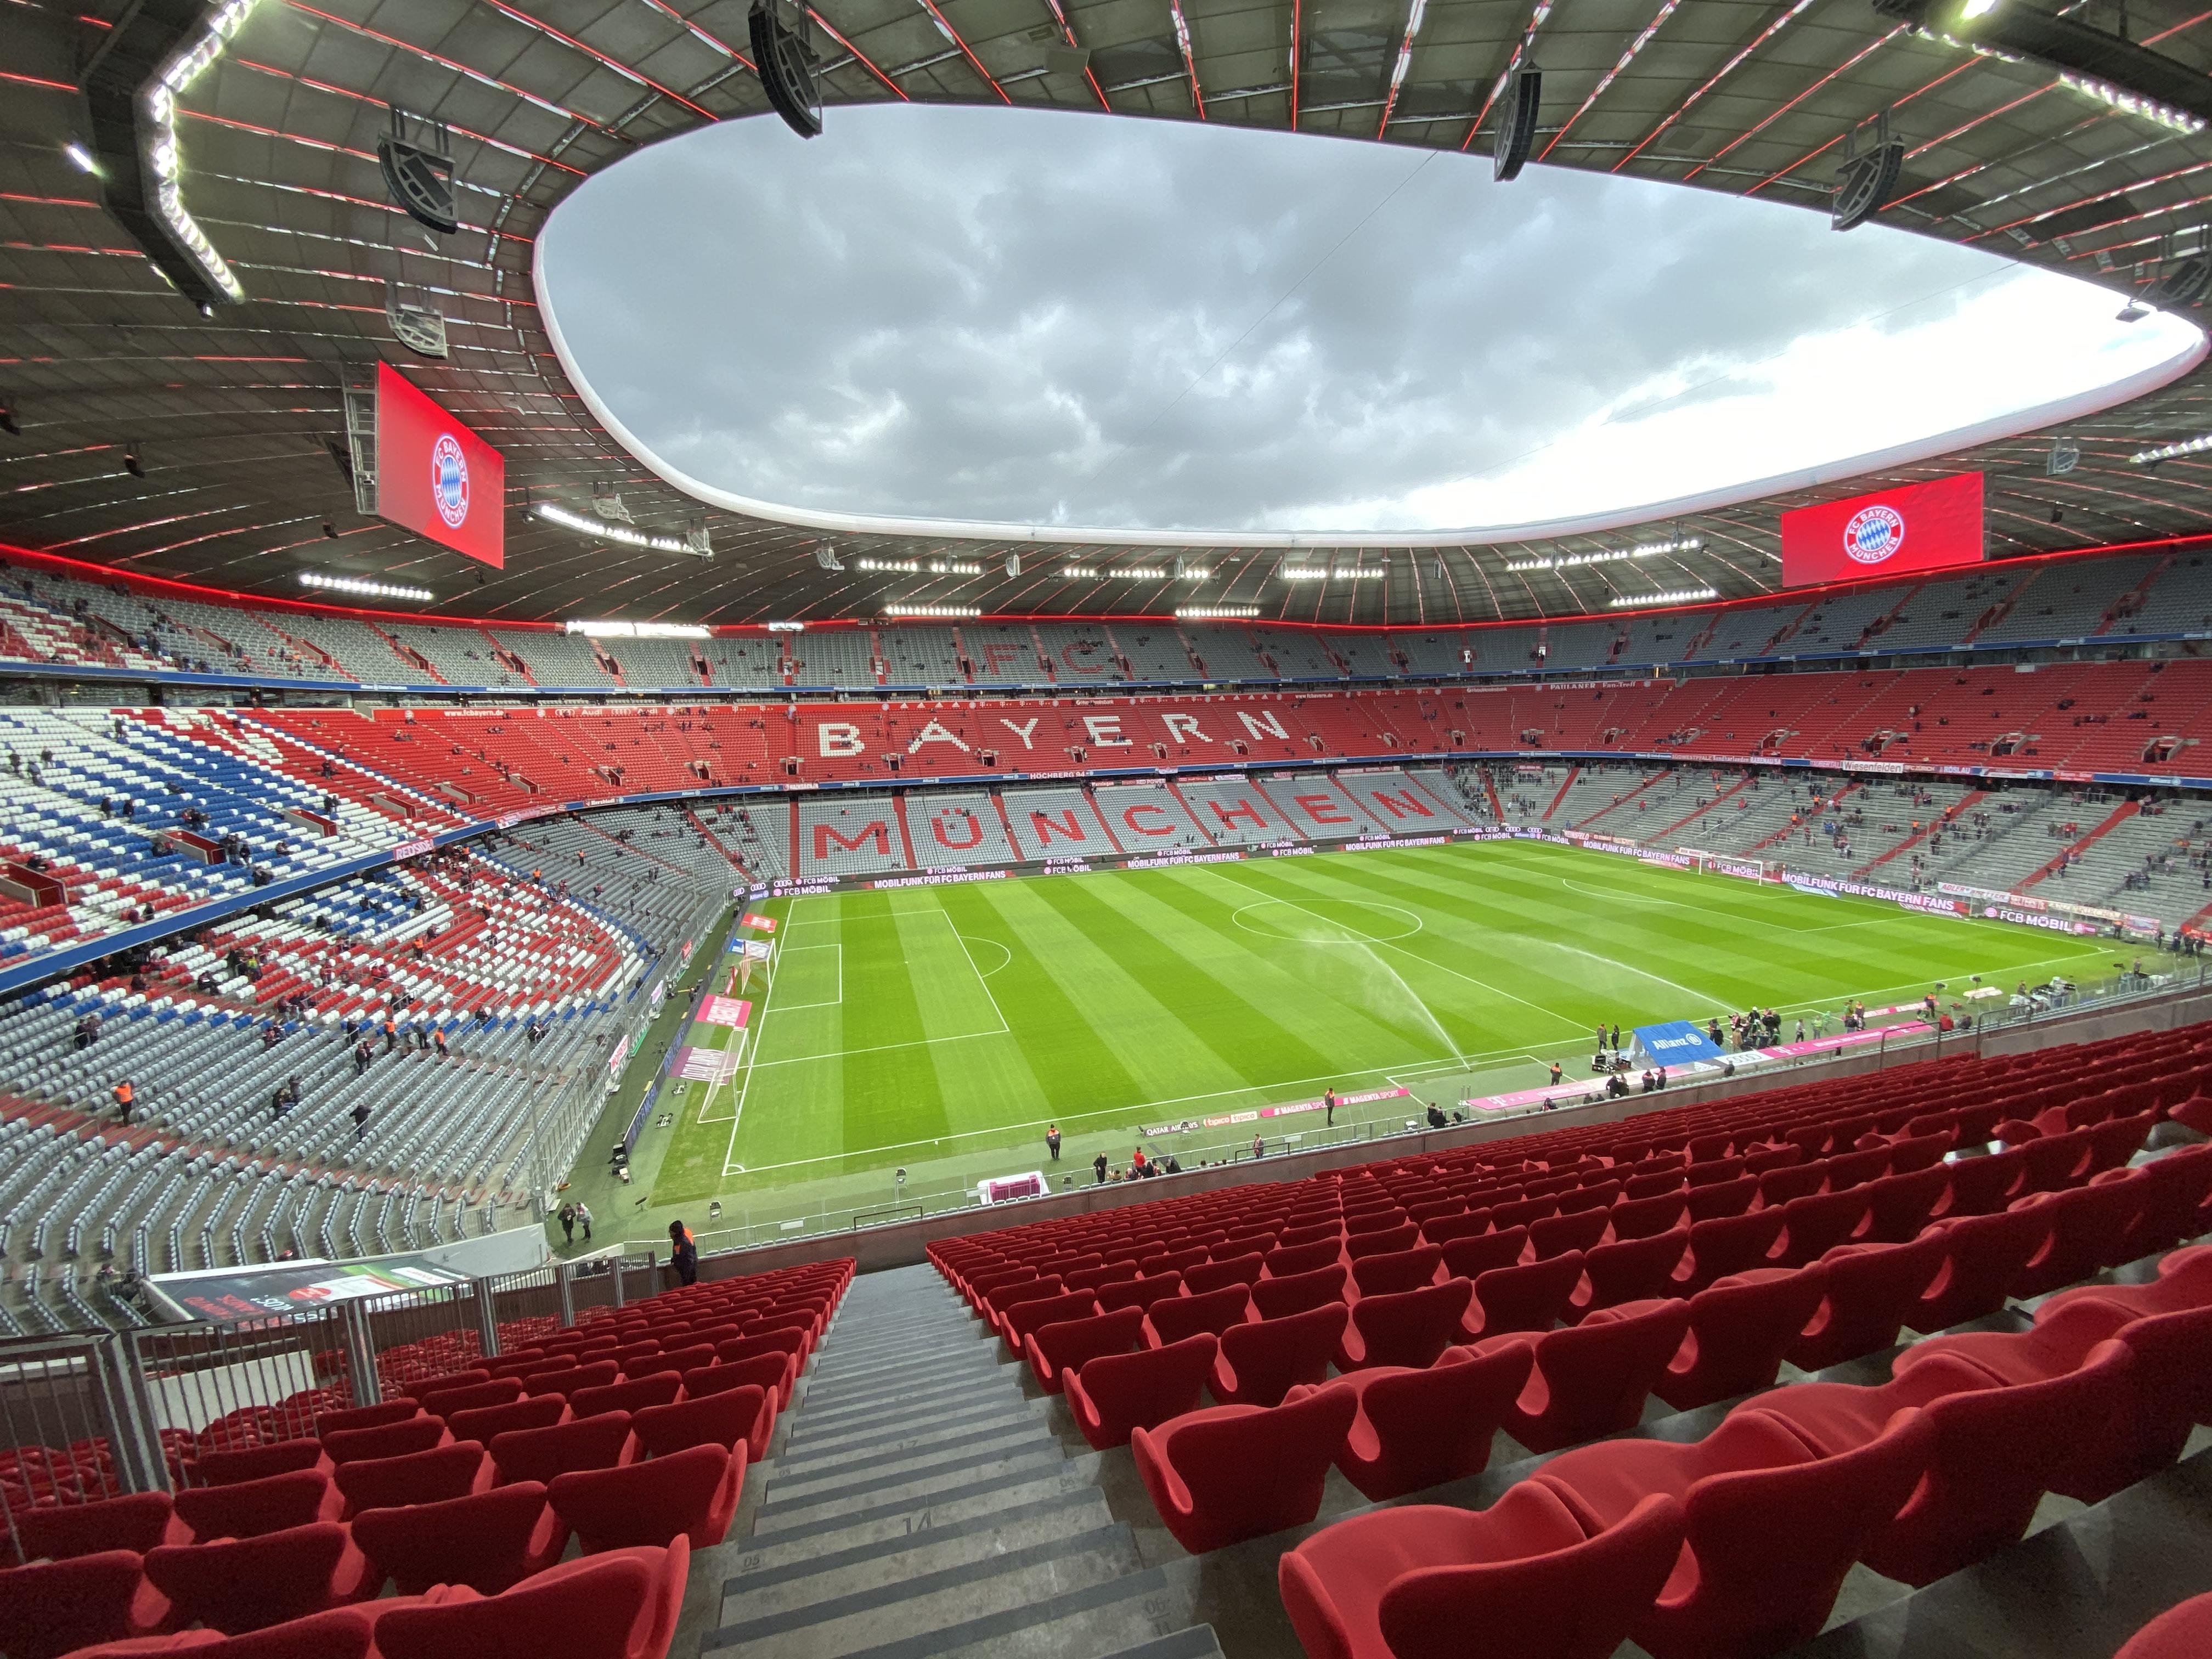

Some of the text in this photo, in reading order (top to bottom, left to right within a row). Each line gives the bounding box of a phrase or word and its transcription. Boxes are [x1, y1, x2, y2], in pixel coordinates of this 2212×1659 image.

[436, 441, 466, 483] FC BAYERN
[1849, 509, 1899, 535] FC BAYERN
[985, 643, 1104, 674] FC
[444, 709, 504, 718] www.fcbayern.de
[819, 710, 1289, 757] BAYERN
[1844, 761, 1901, 773] Wiesenfelden
[813, 789, 1434, 859] MÜNCHEN
[1346, 842, 1383, 851] MOBILFUNK
[1383, 840, 1395, 848] FÜR
[1404, 838, 1429, 847] BAYERN
[1430, 836, 1445, 844] FANS
[1552, 836, 1570, 845] MÖBIL
[1293, 847, 1314, 855] MÖBIL
[1583, 840, 1619, 854] MOBILFUNK
[1620, 846, 1633, 856] FÜR
[1633, 849, 1642, 857] FC
[1643, 850, 1671, 862] BAYERN
[1671, 853, 1690, 865] FANS
[1127, 852, 1239, 868] MOBILFUNK FÜR FC BAYERN FANS
[1717, 863, 1731, 873] FCB
[817, 876, 840, 884] MÖBIL
[874, 870, 1006, 889] MOBILFUNK FÜR FC BAYERN FANS
[784, 885, 831, 896] FCB MÖBIL
[1782, 873, 1838, 891] MOBILFUNK
[1839, 882, 1860, 895] FÜR
[1861, 887, 1875, 898] FC
[1876, 889, 1922, 905] BAYERN
[1923, 896, 1954, 911] FANS
[2000, 911, 2073, 932] FCB MÖBIL
[1652, 1037, 1688, 1050] Allianz
[1350, 1089, 1400, 1104] MAGENTA SPORT
[1280, 1101, 1328, 1114] MAGENTA SPO
[1207, 1118, 1229, 1126] tipico
[1234, 1113, 1255, 1122] tipico
[1147, 1126, 1169, 1136] QATAR
[902, 1511, 932, 1536] 14
